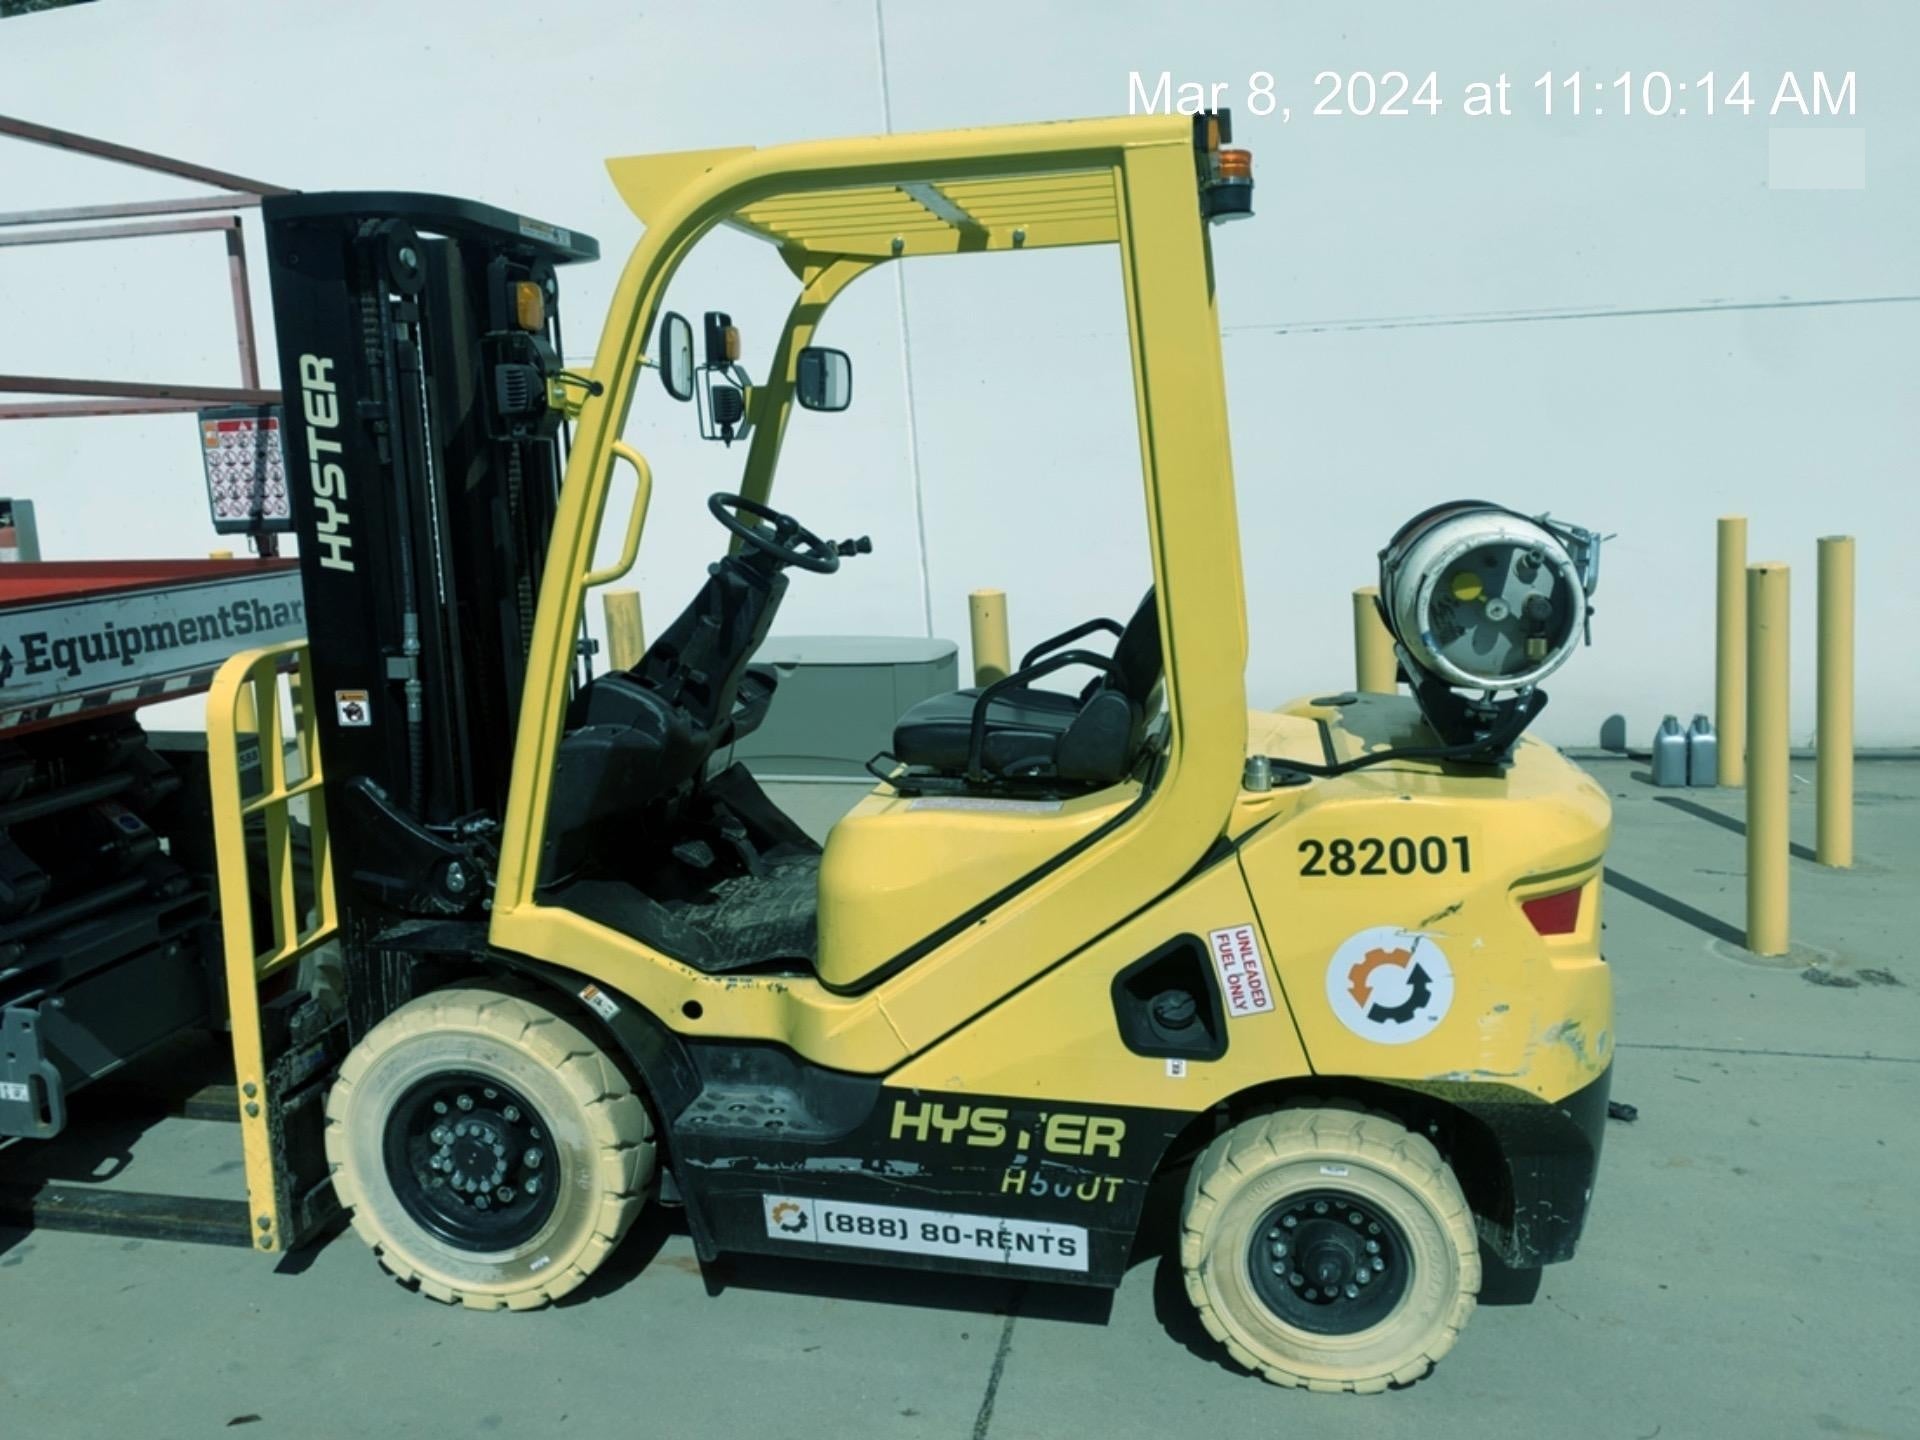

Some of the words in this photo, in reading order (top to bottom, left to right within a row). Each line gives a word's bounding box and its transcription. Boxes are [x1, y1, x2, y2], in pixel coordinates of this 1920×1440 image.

[300, 354, 354, 572] HYSTER
[1298, 836, 1470, 877] 282001
[1217, 933, 1236, 971] FUEL
[1228, 974, 1248, 1010] ONLY
[1236, 929, 1267, 1008] UNLEADED
[824, 1211, 908, 1240] (888)
[920, 1223, 1077, 1257] 80-RENTS
